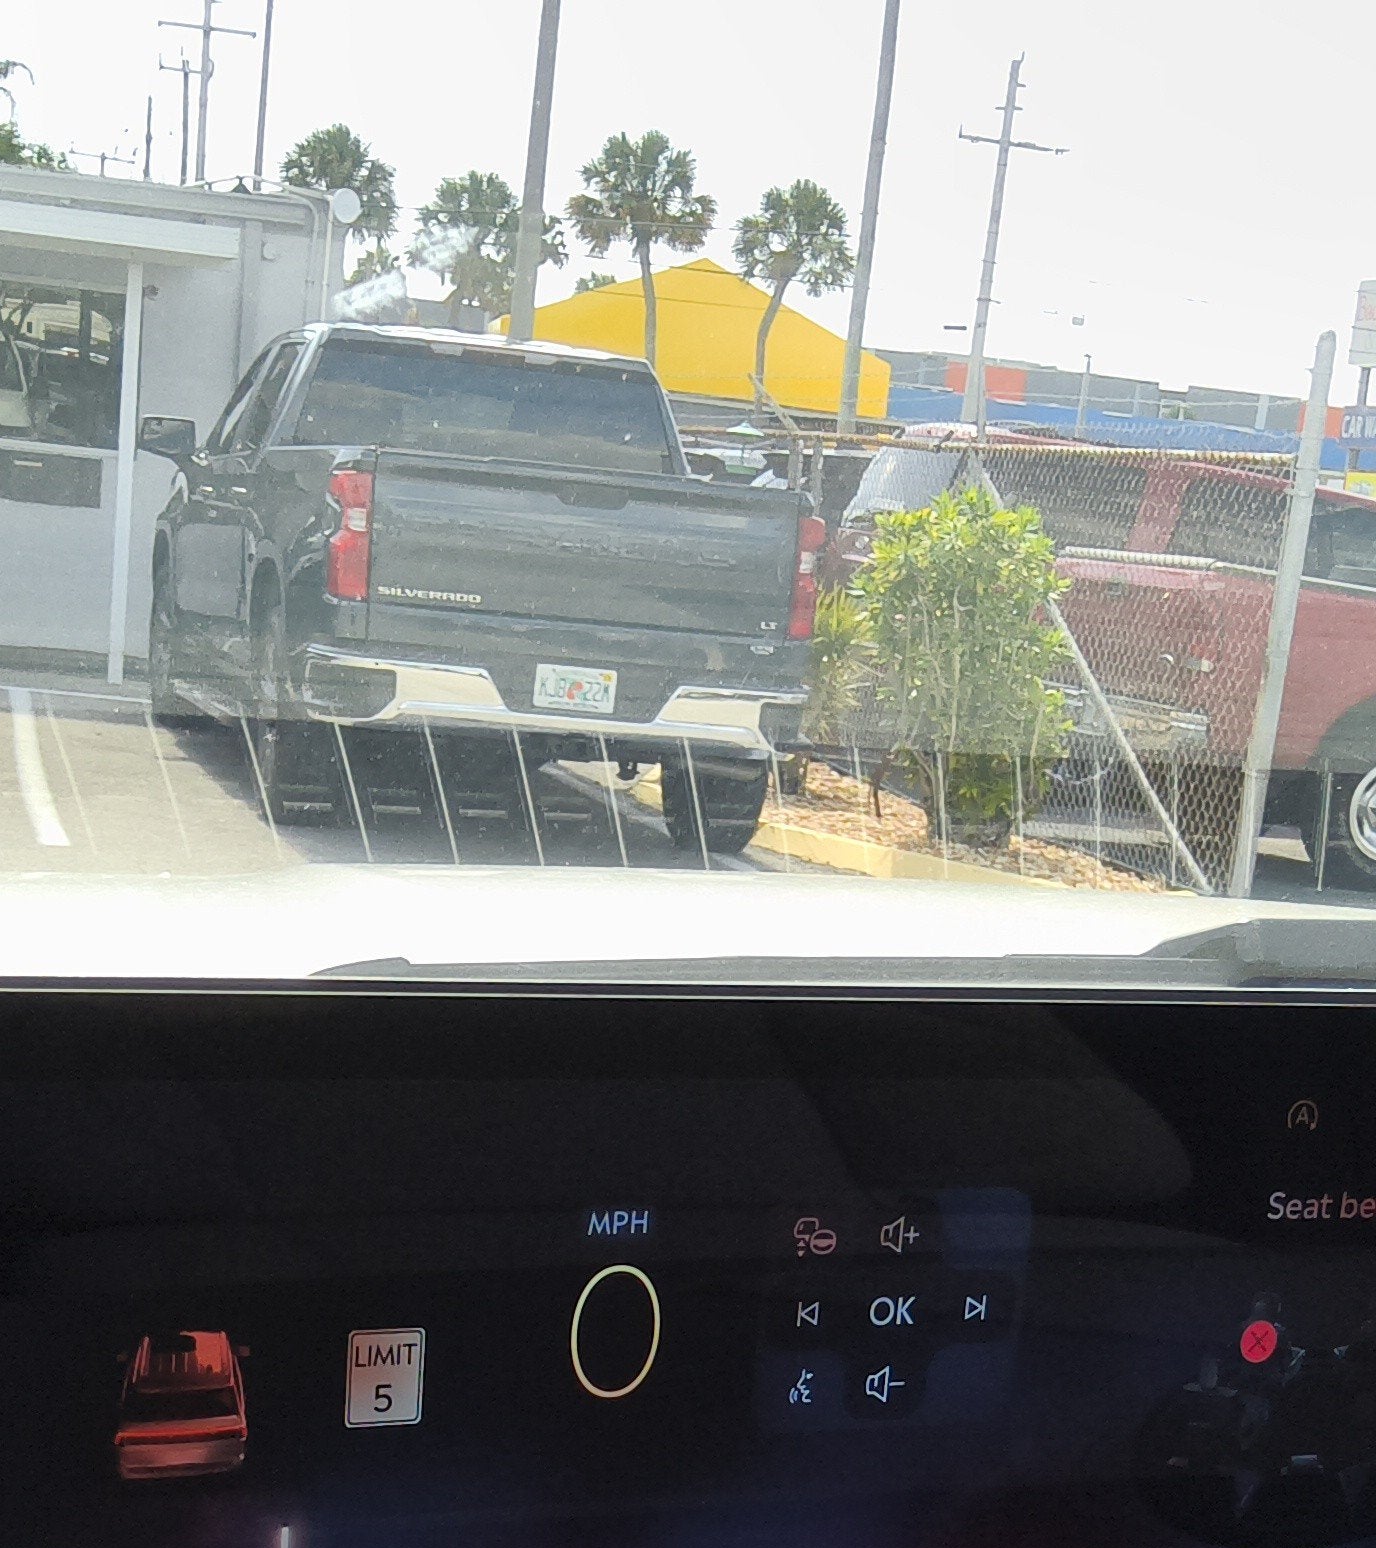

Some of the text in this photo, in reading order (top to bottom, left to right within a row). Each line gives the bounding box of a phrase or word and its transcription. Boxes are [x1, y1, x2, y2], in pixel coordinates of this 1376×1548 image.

[1341, 415, 1363, 438] CAR
[377, 585, 482, 604] SILVERADO
[759, 621, 778, 631] LT
[1267, 1191, 1332, 1221] Seat
[587, 1211, 650, 1237] MPH
[869, 1296, 916, 1327] OK
[571, 1264, 661, 1398] 0
[354, 1342, 417, 1370] LIMIT
[372, 1384, 394, 1414] 5
